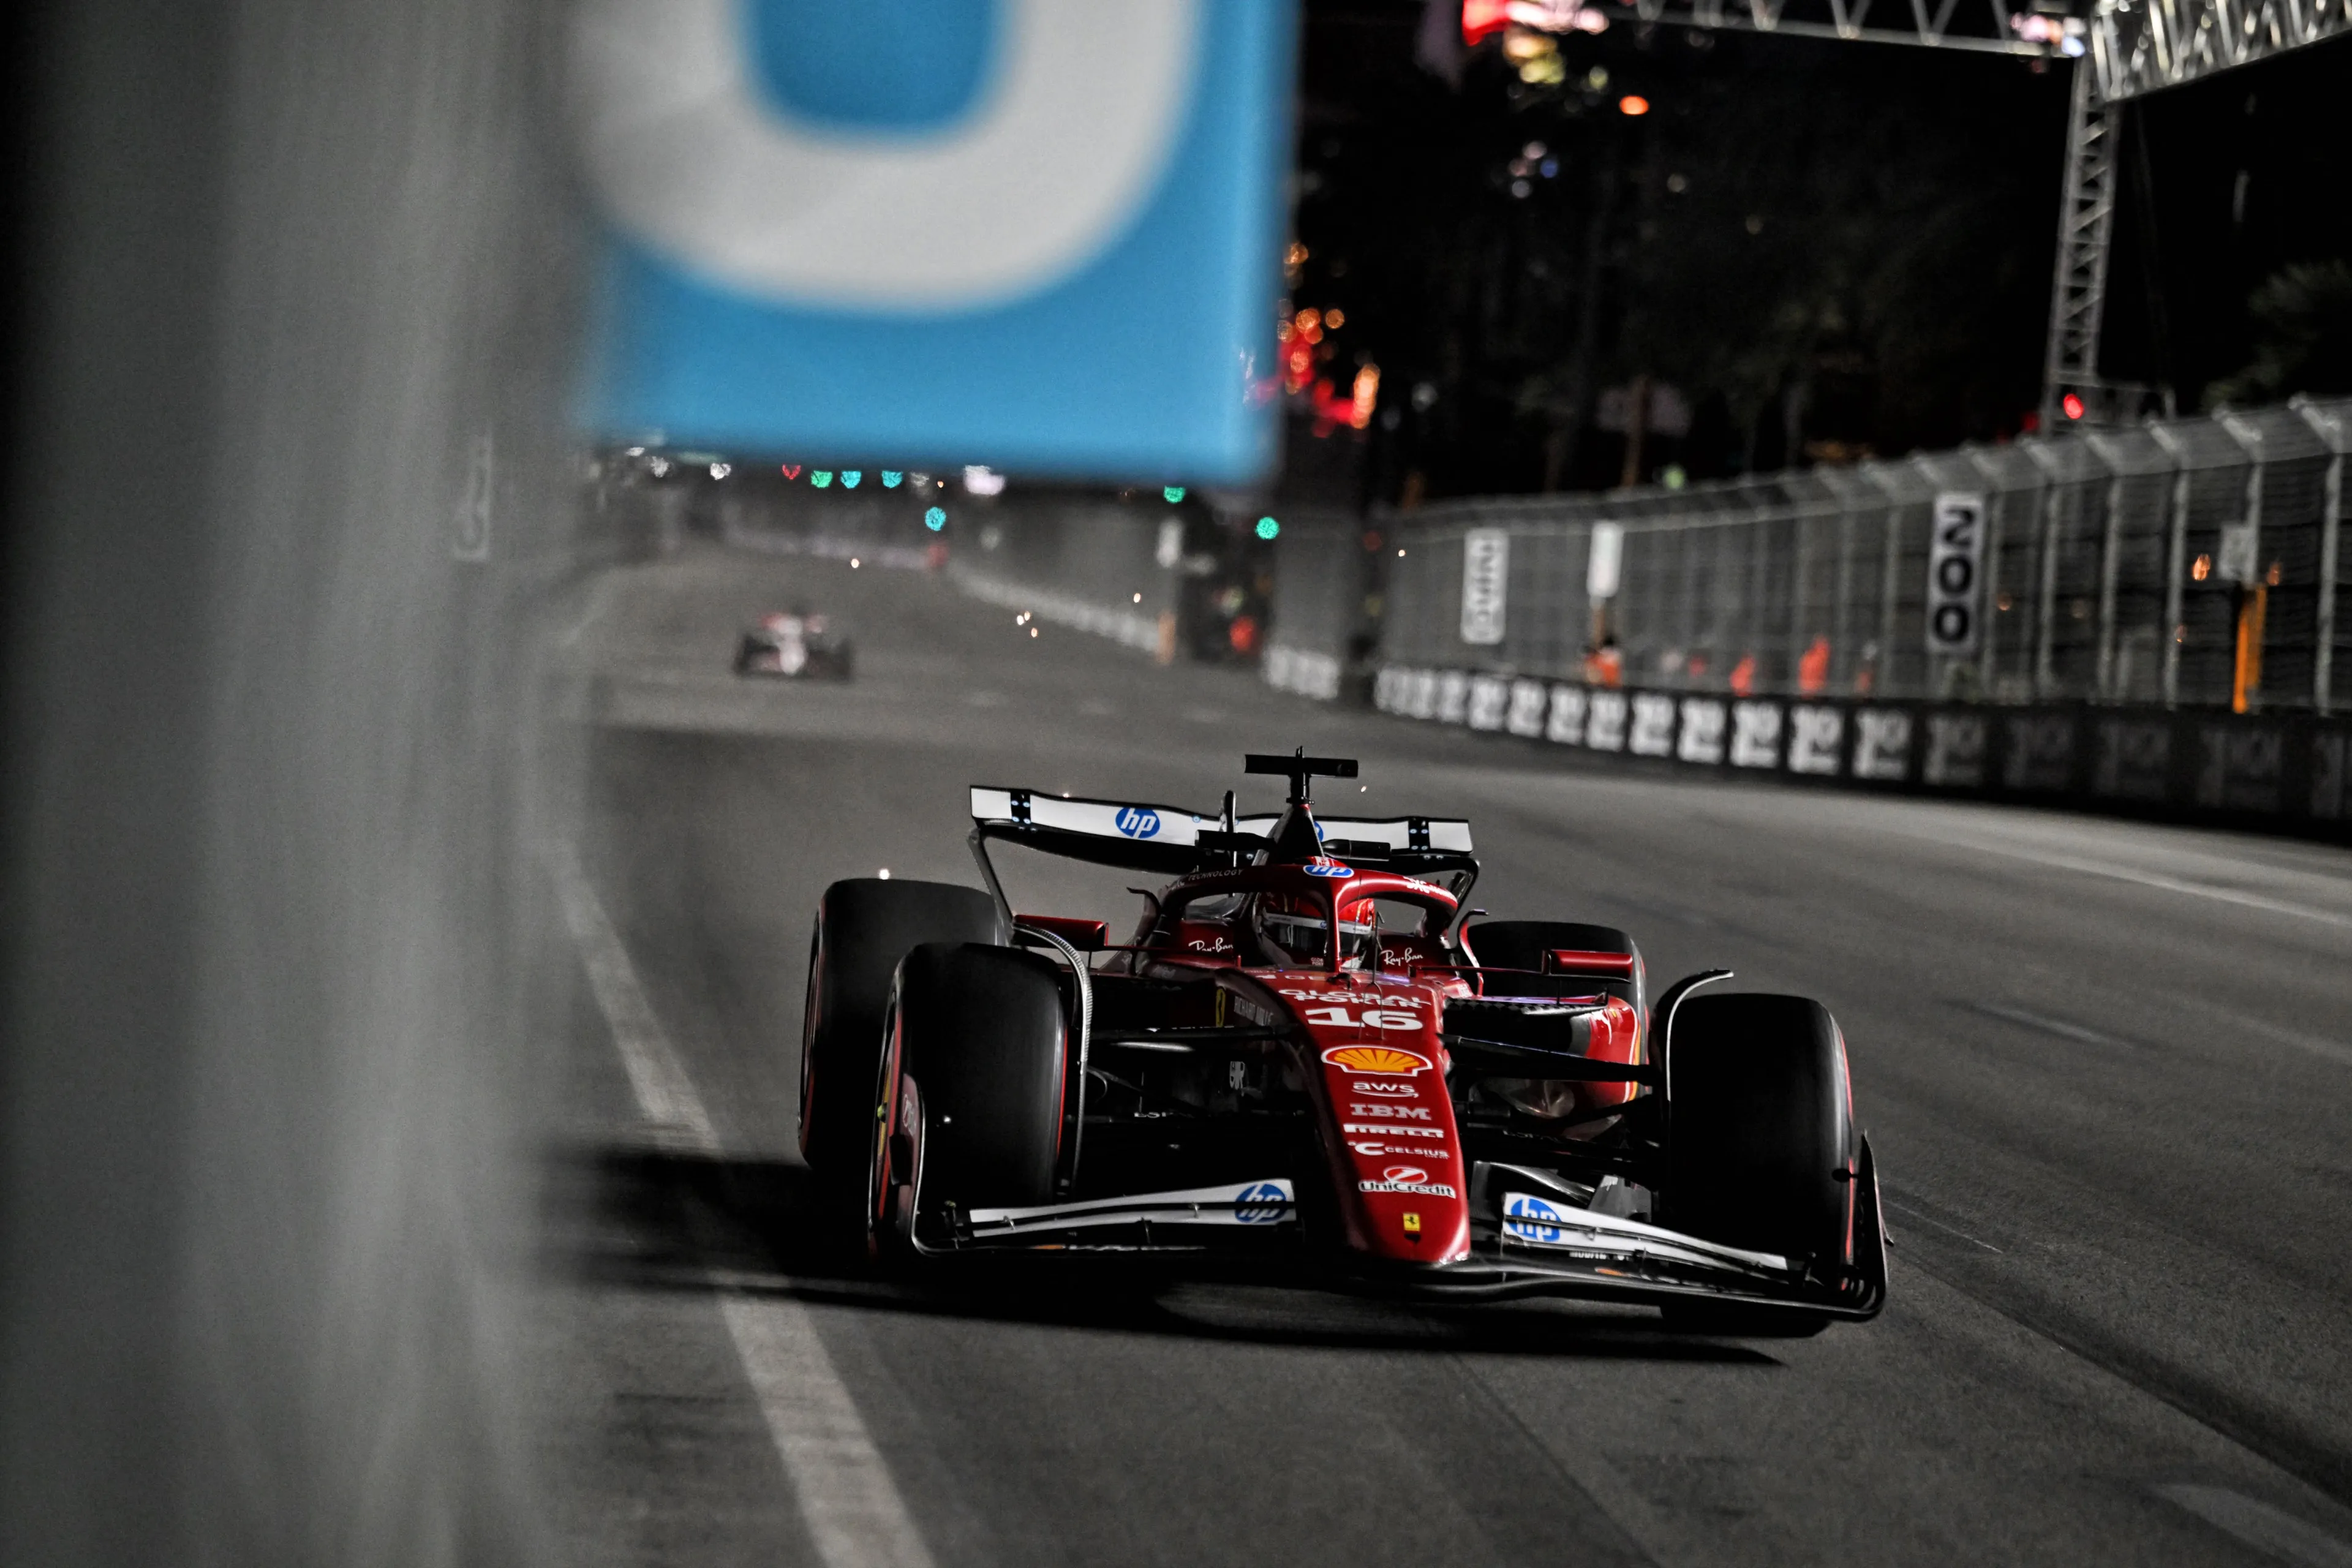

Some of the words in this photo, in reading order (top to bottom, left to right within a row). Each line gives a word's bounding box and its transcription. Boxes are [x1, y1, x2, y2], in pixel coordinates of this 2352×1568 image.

[1934, 507, 1974, 643] 200
[1120, 807, 1157, 839] hp
[1278, 989, 1431, 1006] GLOBAL
[1305, 1007, 1423, 1030] 16
[1352, 1081, 1415, 1093] aws
[1349, 1103, 1432, 1120] IBM
[1343, 1123, 1444, 1138] PIRELLI
[1384, 1146, 1450, 1158] CELSIUS
[1359, 1180, 1456, 1199] UniCredit
[1238, 1183, 1284, 1224] hp
[1516, 1197, 1558, 1243] hp
